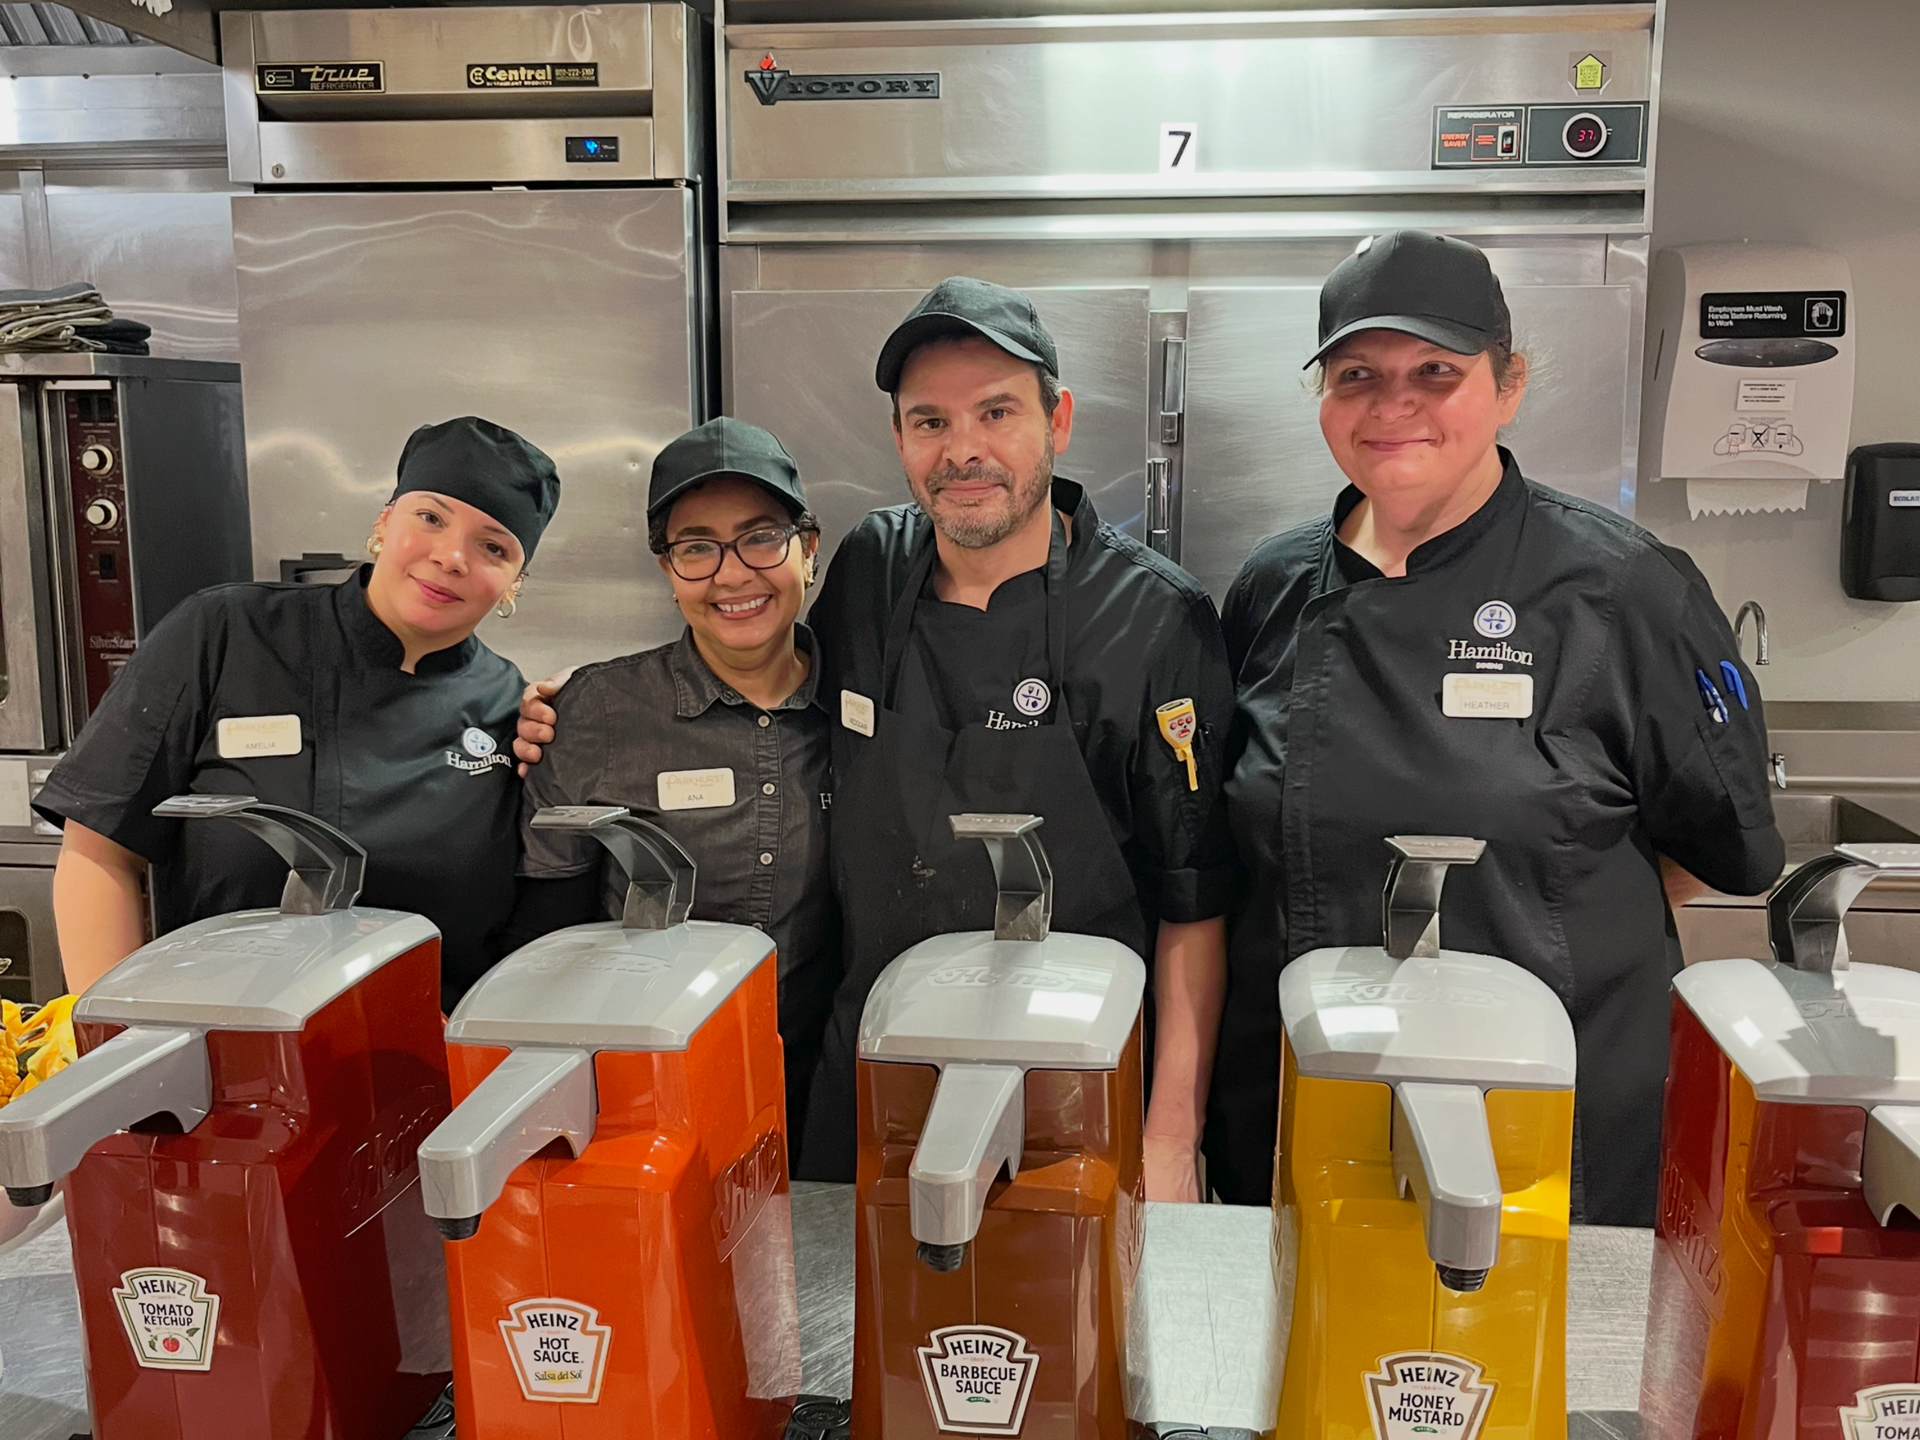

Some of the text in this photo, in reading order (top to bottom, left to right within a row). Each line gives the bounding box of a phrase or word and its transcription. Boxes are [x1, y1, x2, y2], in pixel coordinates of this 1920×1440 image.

[301, 66, 374, 81] true
[485, 64, 552, 81] Central
[310, 82, 374, 90] REFRIGERATOR
[1447, 111, 1514, 119] REFRIGERATOR
[1169, 131, 1191, 167] 7
[1443, 140, 1467, 148] SAVER
[1708, 305, 1745, 313] Employees
[1754, 312, 1787, 320] Returning
[1447, 639, 1533, 666] Hamilton
[1464, 701, 1510, 710] HEATHER
[227, 720, 290, 736] PARKHURST
[245, 742, 276, 750] AMELIA
[446, 751, 512, 770] Hamilton
[666, 774, 725, 790] PARKHURST
[687, 794, 704, 802] ANA
[138, 1279, 188, 1296] HEINZ
[139, 1303, 194, 1317] TOMATO
[144, 1315, 193, 1327] KETCHUP
[527, 1313, 579, 1331] HEINZ
[539, 1337, 570, 1350] HOT
[950, 1339, 1005, 1358] HEINZ
[533, 1349, 580, 1363] SAUCE
[535, 1370, 583, 1381] Salsa del Sol
[941, 1363, 1017, 1381] BARBECUE
[1400, 1367, 1459, 1387] HEINZ
[956, 1380, 1001, 1395] SAUCE
[1400, 1393, 1455, 1410] HONEY
[1389, 1406, 1464, 1426] MUSTARD
